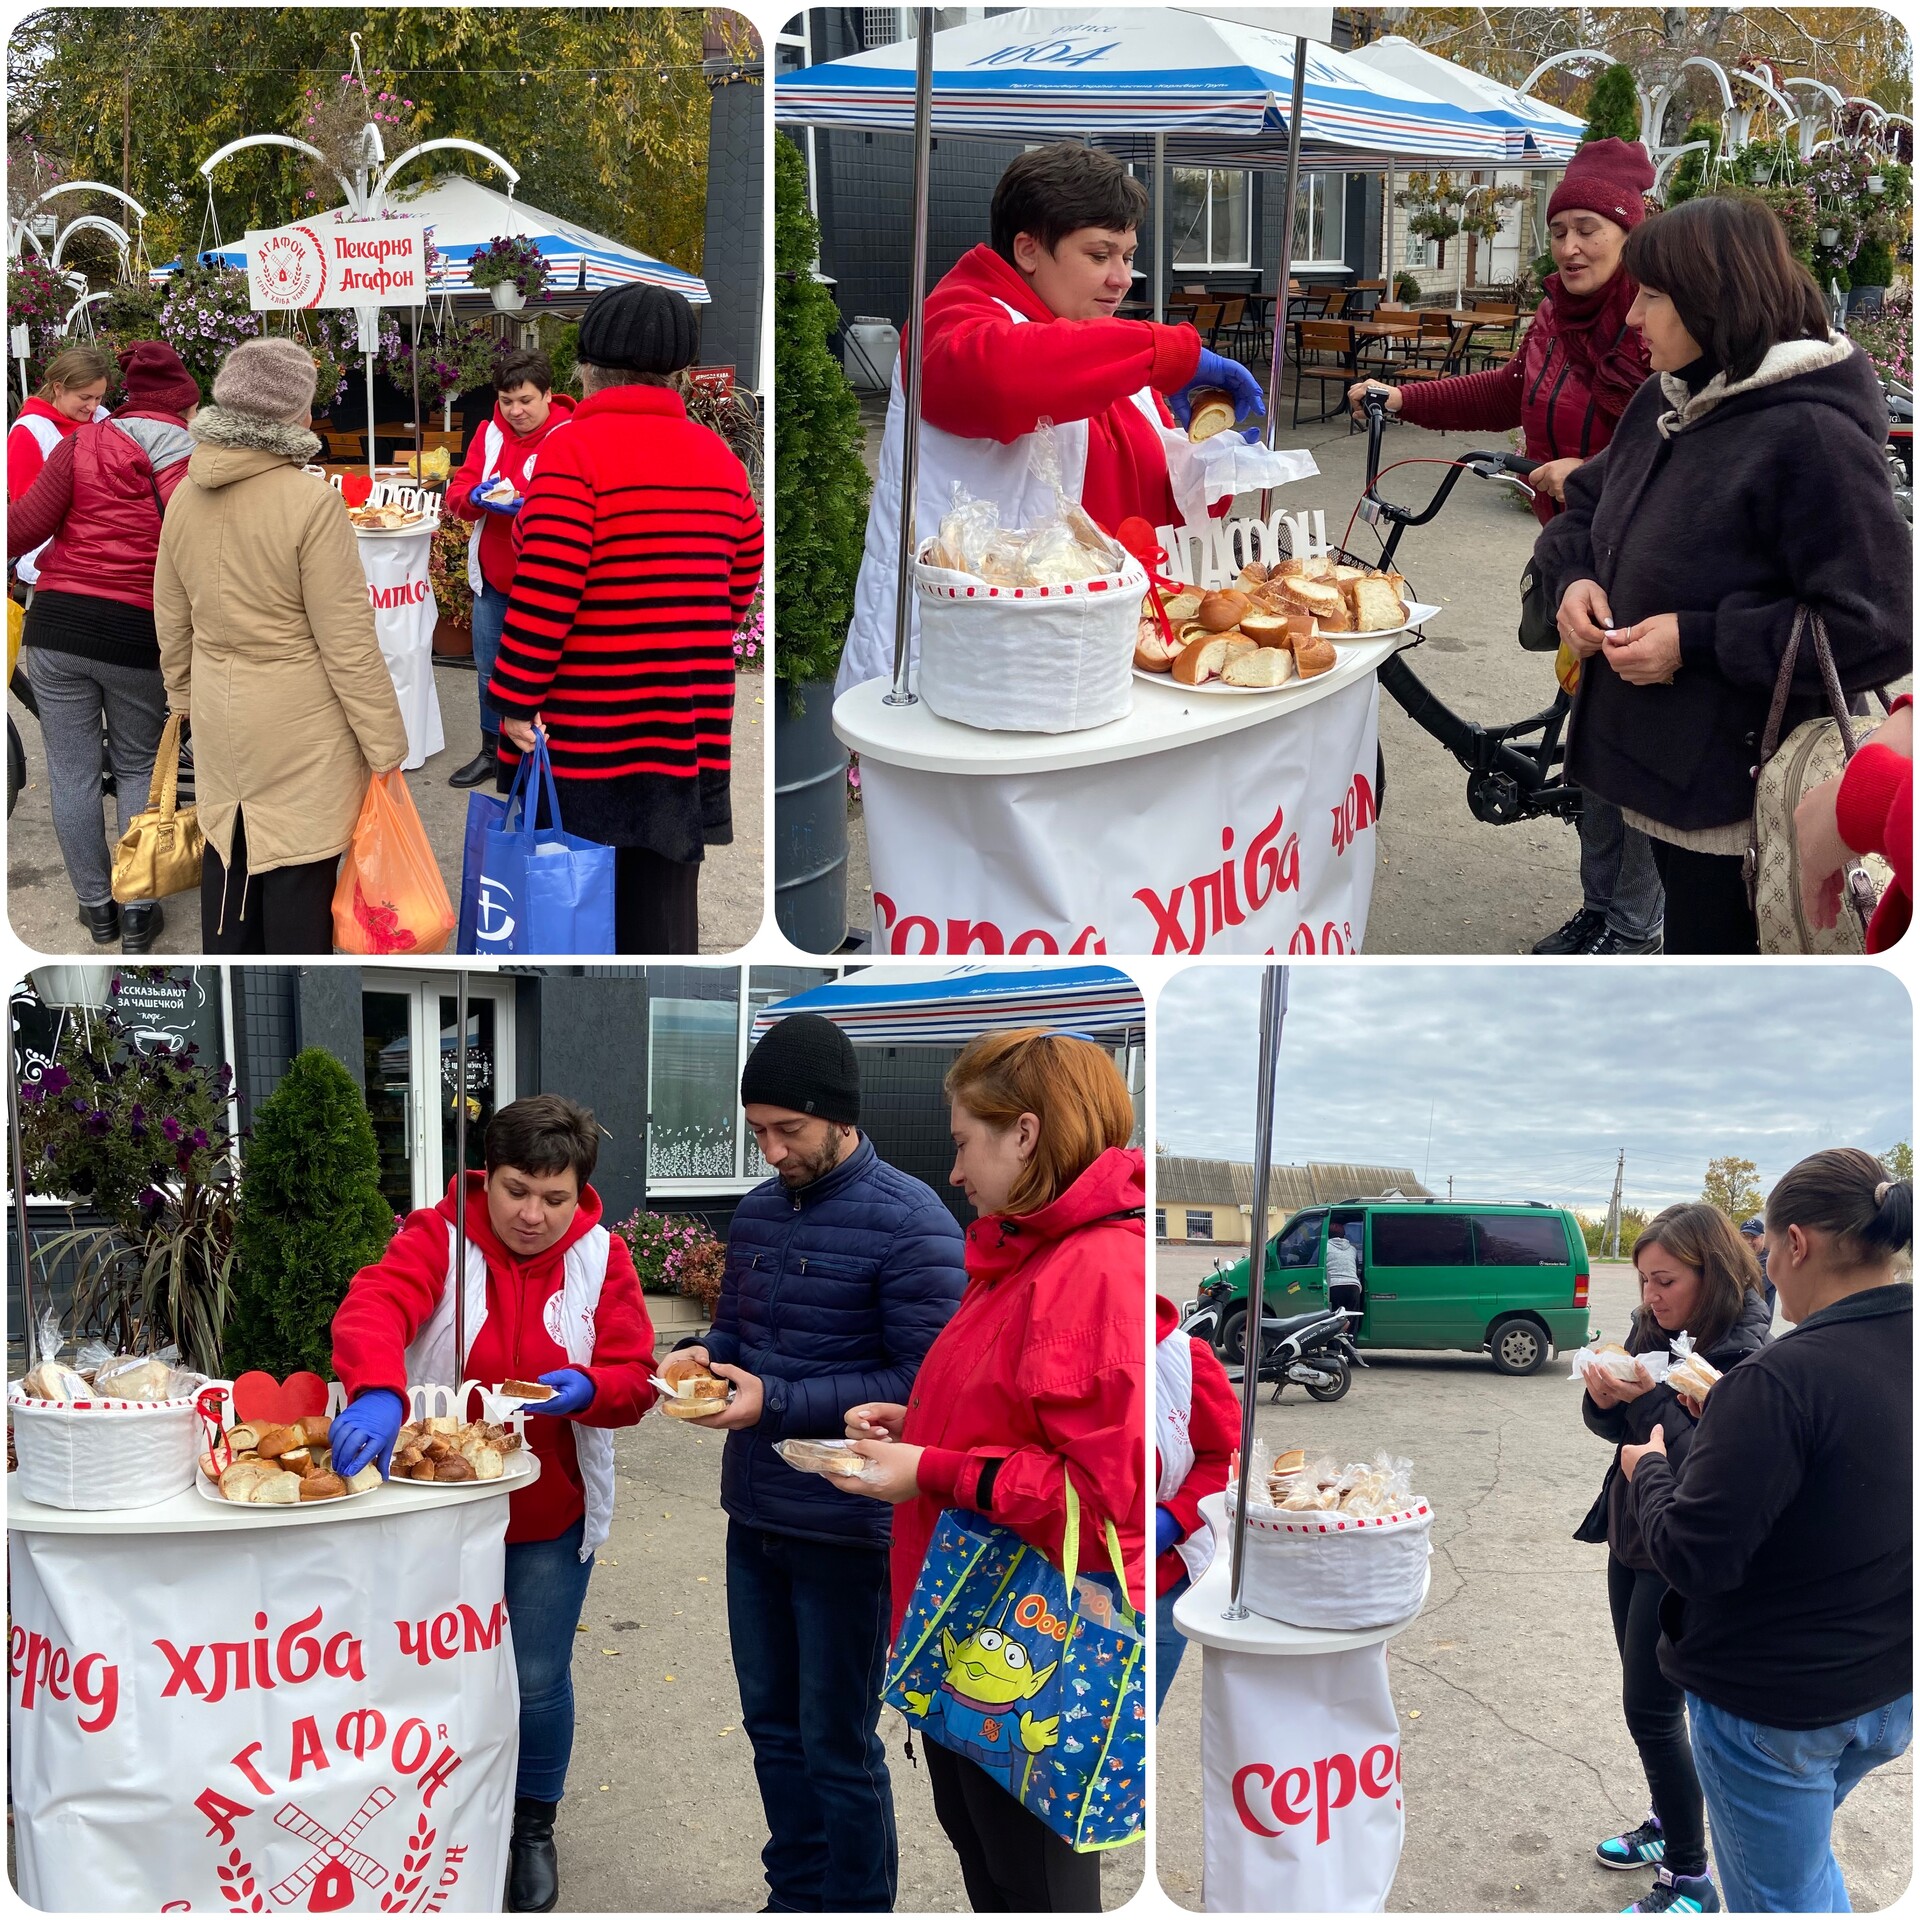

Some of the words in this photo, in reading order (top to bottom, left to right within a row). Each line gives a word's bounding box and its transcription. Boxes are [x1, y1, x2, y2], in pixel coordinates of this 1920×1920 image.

[965, 37, 1123, 67] 1664
[258, 236, 307, 262] АГАФОН
[334, 236, 413, 265] Пекарня
[339, 267, 414, 295] Агафон
[1131, 804, 1300, 955] хліба
[117, 985, 187, 998] АССКАЗЫВАЮТ
[117, 998, 131, 1007] ЗА
[131, 998, 184, 1009] ЧАШЕЧКОЙ
[10, 1625, 120, 1733] еред
[151, 1605, 367, 1703] хліба
[393, 1596, 508, 1666] чем
[193, 1708, 462, 1847] АГАФОН
[1231, 1743, 1402, 1847] Сере
